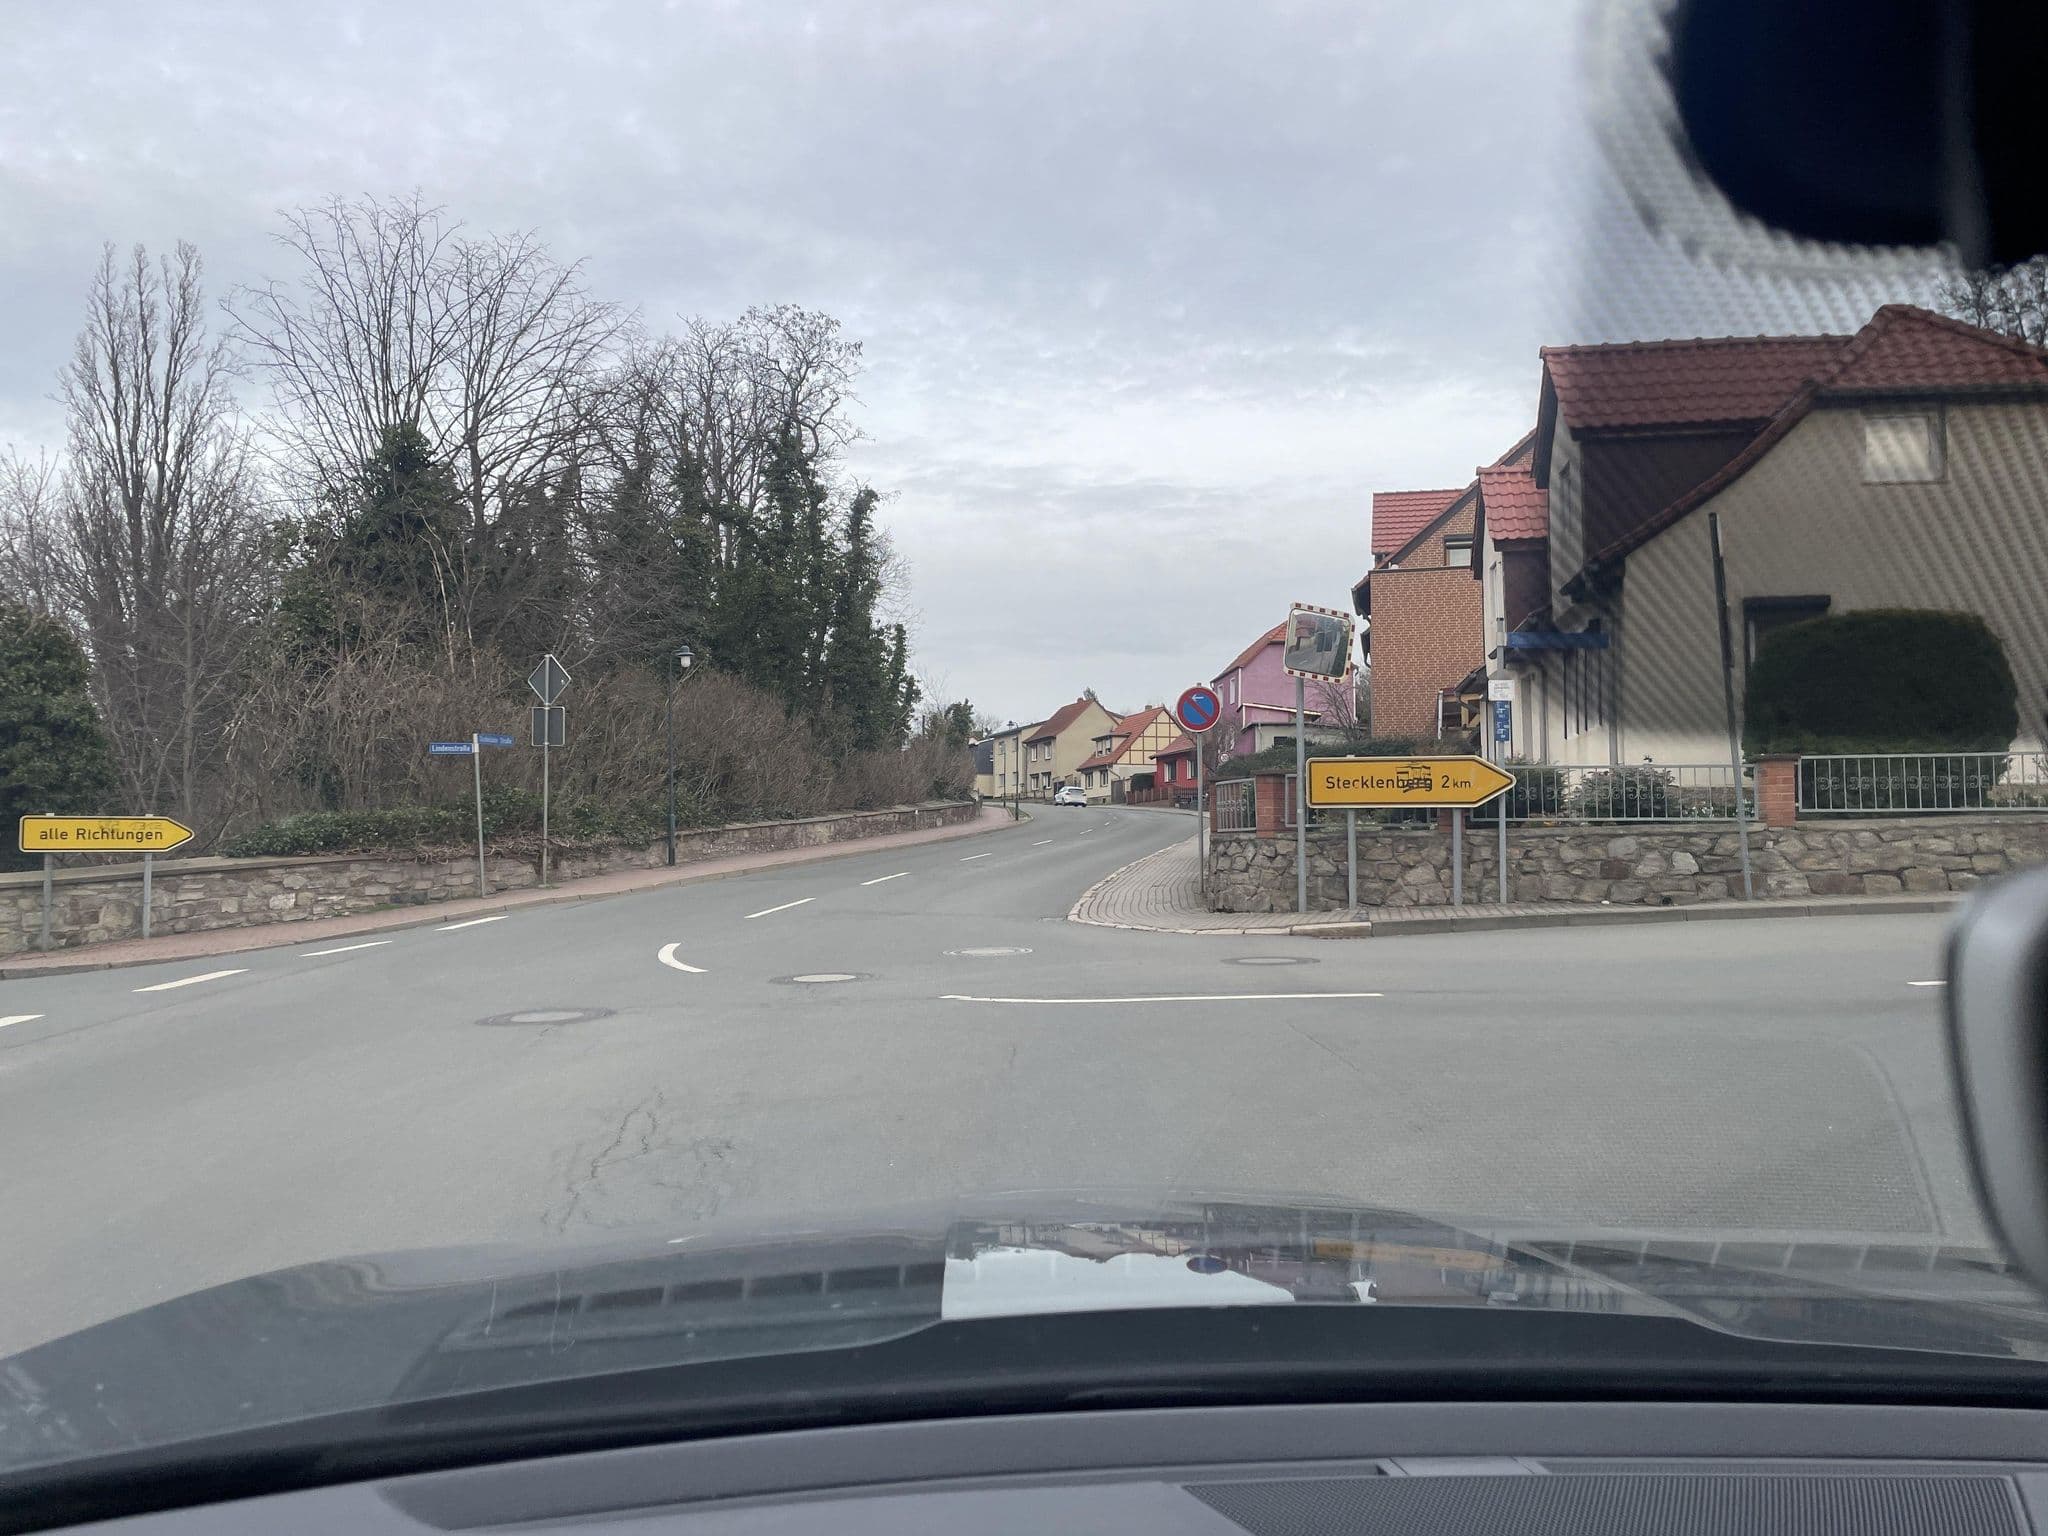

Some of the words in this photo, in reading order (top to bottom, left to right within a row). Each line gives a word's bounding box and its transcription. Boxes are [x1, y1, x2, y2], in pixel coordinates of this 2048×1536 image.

[431, 744, 470, 752] Lindenstraße
[1441, 775, 1450, 789] 2
[1453, 778, 1471, 789] km
[39, 828, 68, 840] alle
[76, 828, 163, 843] Richtungen
